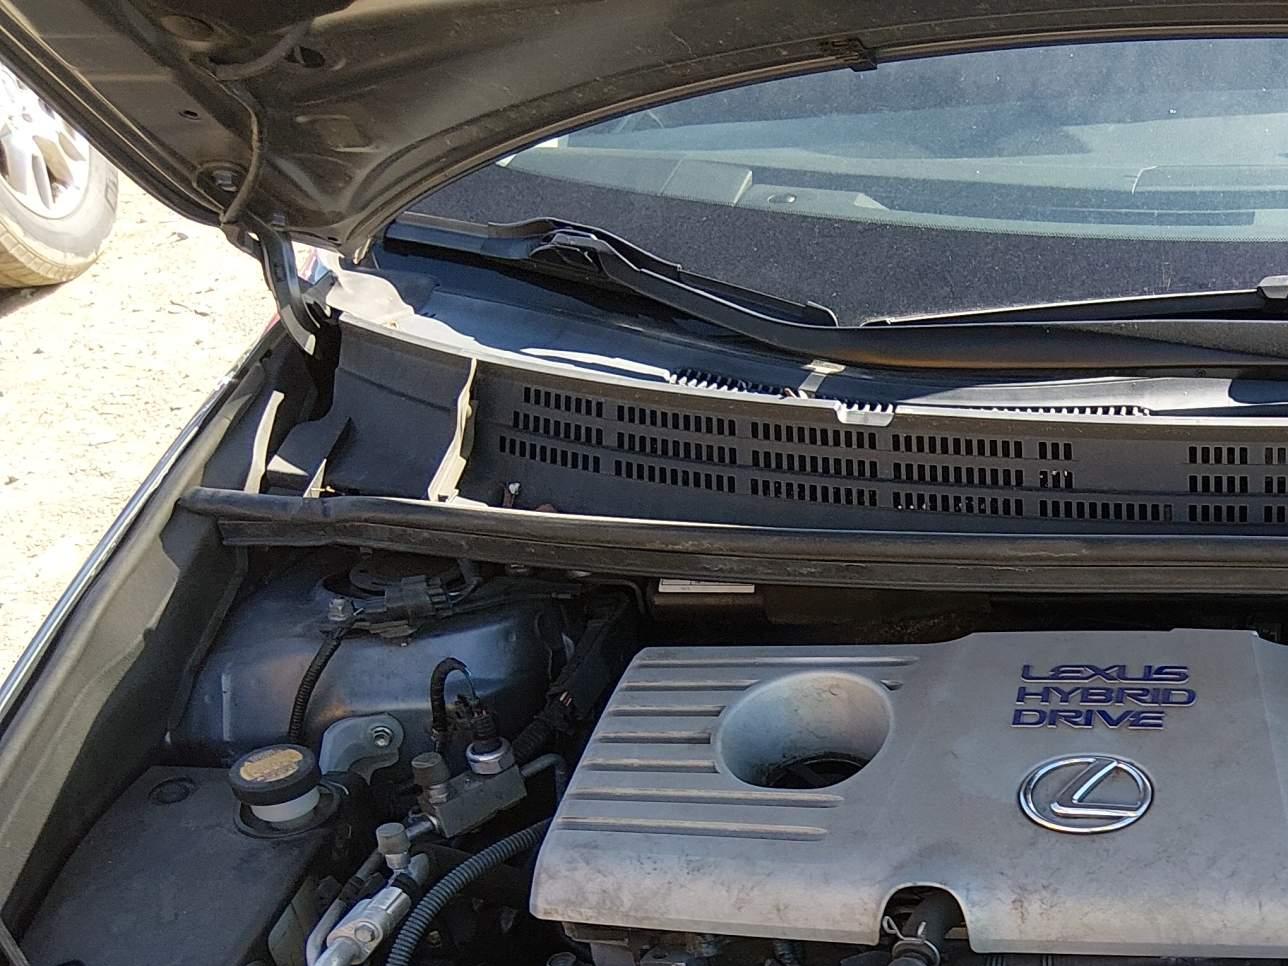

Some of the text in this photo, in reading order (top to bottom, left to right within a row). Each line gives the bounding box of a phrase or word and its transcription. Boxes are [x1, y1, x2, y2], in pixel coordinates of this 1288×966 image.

[1021, 664, 1190, 684] LEXUS
[1015, 686, 1197, 707] HYBRID
[1010, 708, 1165, 729] DRIVE
